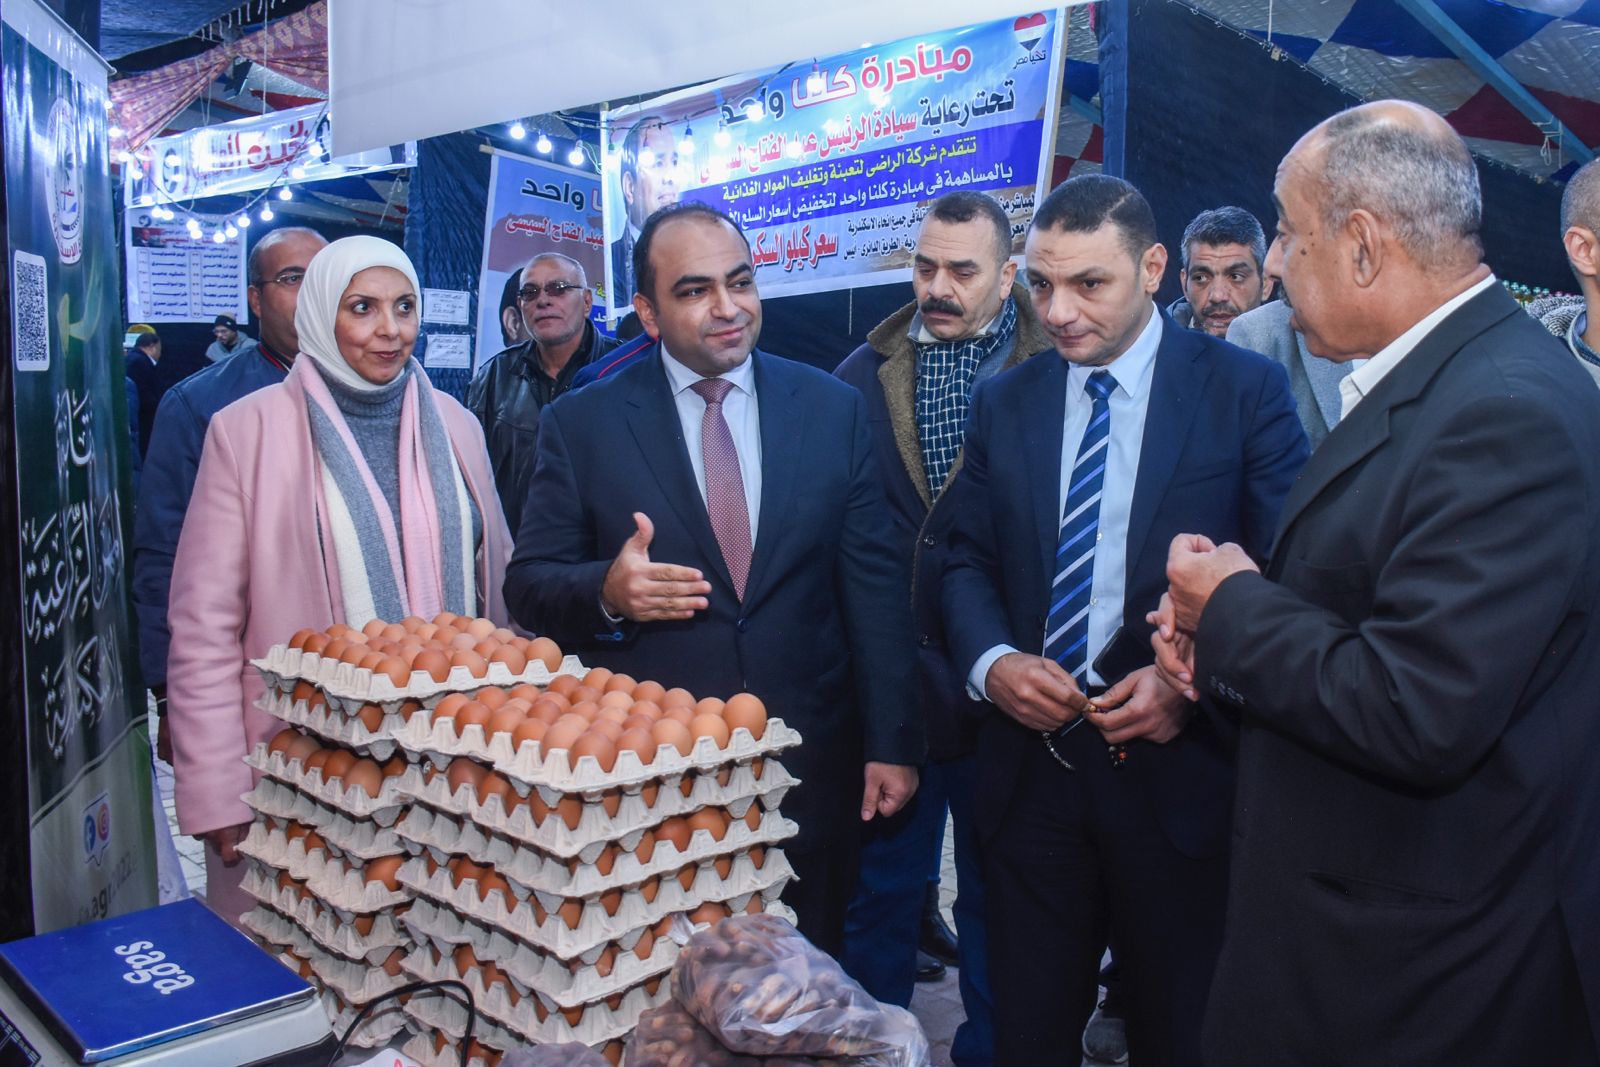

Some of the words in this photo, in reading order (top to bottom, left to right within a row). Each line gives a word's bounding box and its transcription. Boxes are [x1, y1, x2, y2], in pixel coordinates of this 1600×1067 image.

[1012, 56, 1028, 70] مصر
[972, 79, 1015, 116] تحت
[873, 109, 917, 140] سيادة
[920, 98, 969, 134] رعاية
[819, 112, 871, 157] الرئيس
[906, 143, 938, 167] شركة
[939, 136, 977, 164] تتقدم
[830, 159, 864, 183] لتعبئة
[866, 152, 904, 177] الراضى
[944, 162, 1013, 187] بالمساهمة
[763, 175, 790, 195] المواد
[791, 167, 829, 189] وتغليف
[868, 180, 888, 200] كلنا
[890, 178, 924, 200] مبادرة
[926, 172, 943, 195] فى
[521, 178, 585, 210] واحد
[722, 180, 760, 203] الغذائية
[840, 189, 866, 206] واحد
[766, 198, 790, 222] أسعار
[792, 192, 836, 218] لتخفيض
[505, 217, 550, 237] السيسى
[741, 206, 765, 229] السلع
[891, 215, 906, 231] جميع
[551, 220, 584, 242] الفتاح
[752, 231, 783, 269] السكر
[784, 224, 810, 270] كيلو
[809, 233, 838, 267] سعر
[881, 237, 899, 255] الطريق
[114, 941, 195, 994] saga
